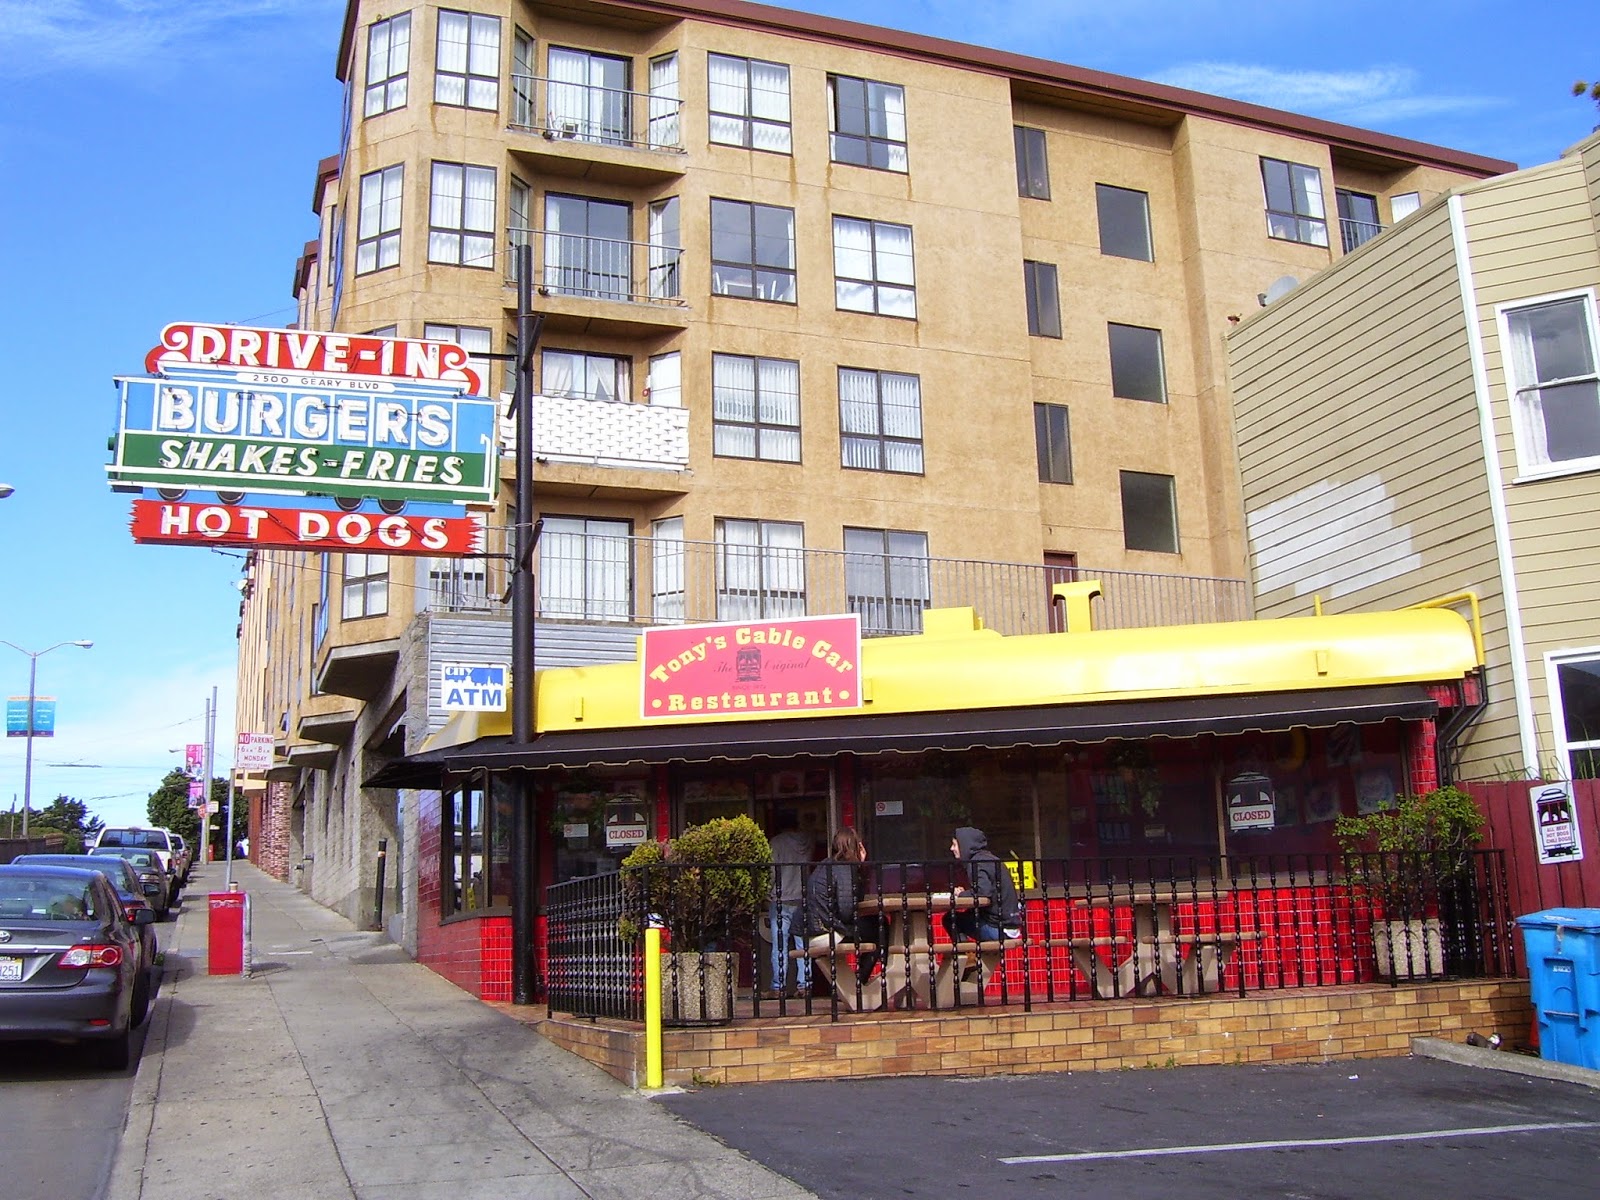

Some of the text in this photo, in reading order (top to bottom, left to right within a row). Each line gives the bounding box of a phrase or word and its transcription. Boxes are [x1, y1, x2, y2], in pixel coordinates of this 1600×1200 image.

[190, 326, 441, 380] DRIVE-IN
[253, 374, 379, 390] 2500 GEARY BLVD
[160, 387, 453, 447] BURGERS
[161, 505, 450, 549] HOT DOGS
[650, 627, 853, 683] Tony's Cable Car
[446, 688, 502, 706] ATM
[668, 687, 833, 712] Restaurant
[239, 733, 274, 744] NO PARKING
[1233, 810, 1271, 822] CLOSED
[609, 829, 644, 839] CLOSED
[0, 965, 19, 976] 251
